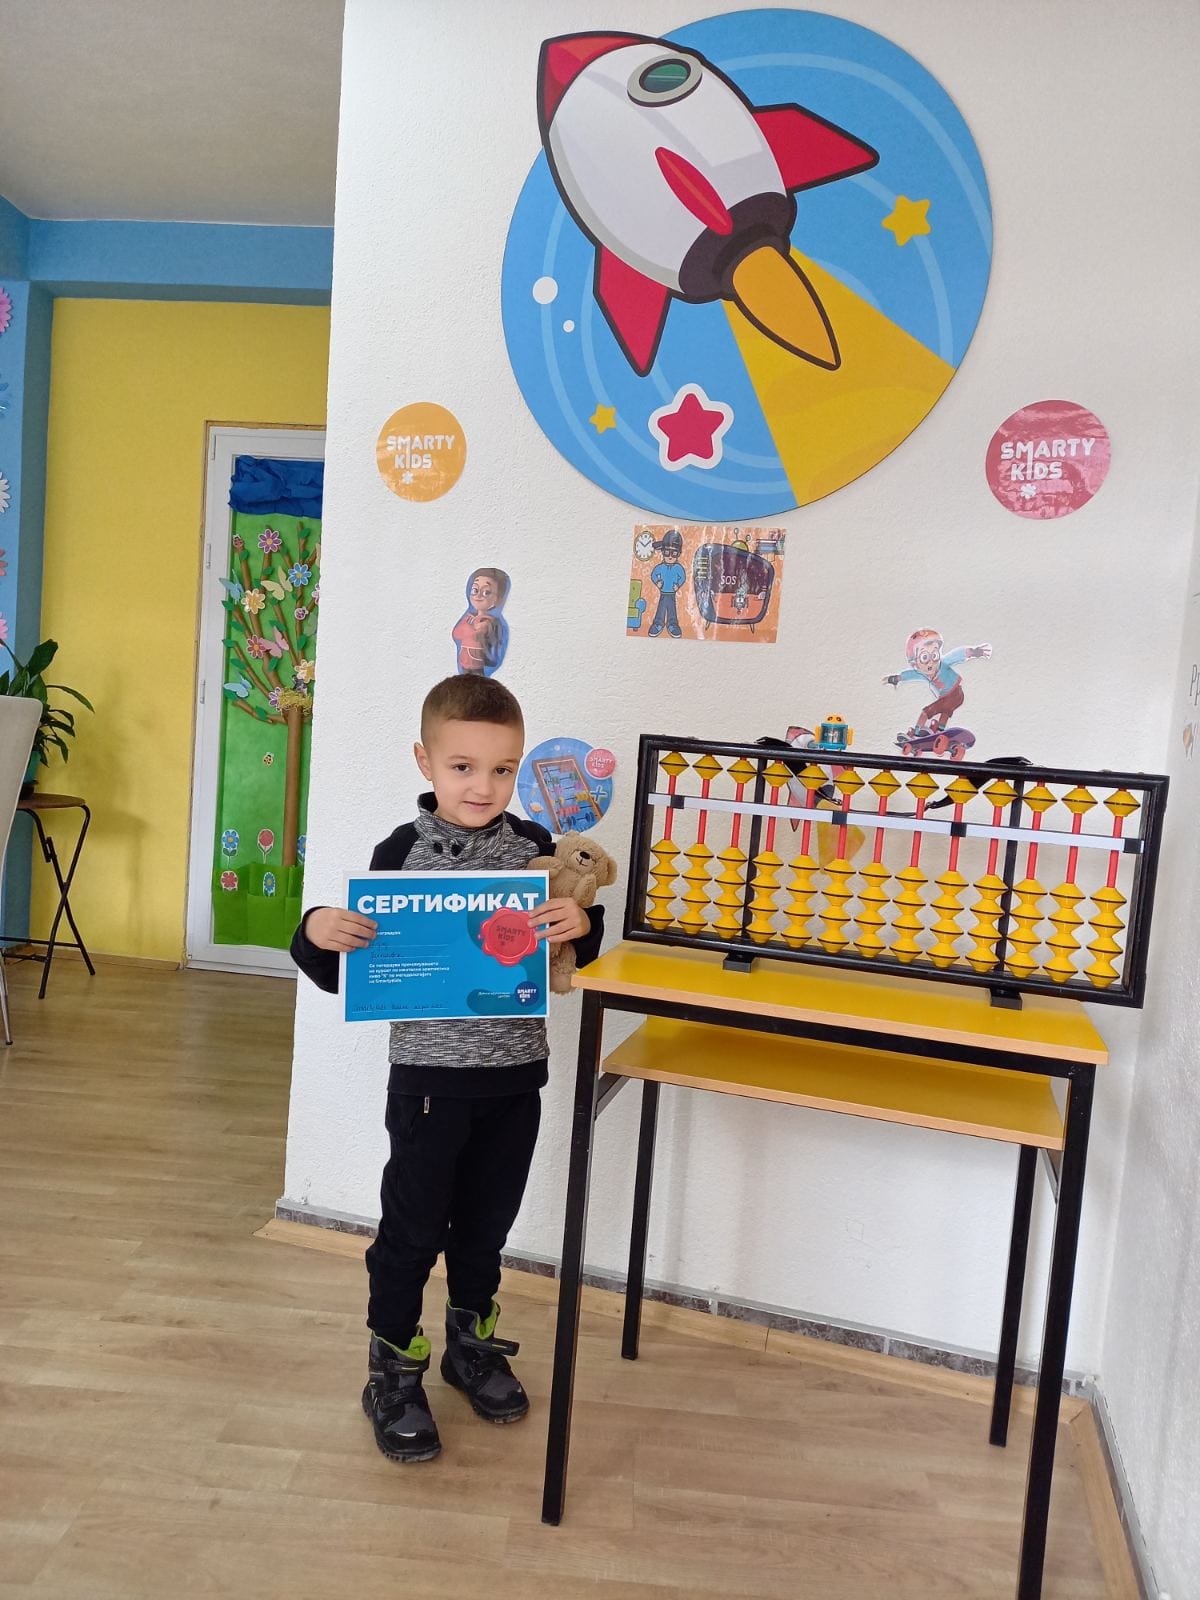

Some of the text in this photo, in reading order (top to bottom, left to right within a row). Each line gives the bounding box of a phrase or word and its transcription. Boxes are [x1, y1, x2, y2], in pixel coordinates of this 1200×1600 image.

[386, 435, 455, 451] SMARTY
[1000, 438, 1095, 460] SMARTY
[394, 453, 433, 469] KIDS
[1011, 461, 1063, 480] KIDS
[720, 575, 737, 585] SOS
[357, 893, 539, 914] СЕРТИФИКАТ
[496, 925, 526, 936] SMARTY
